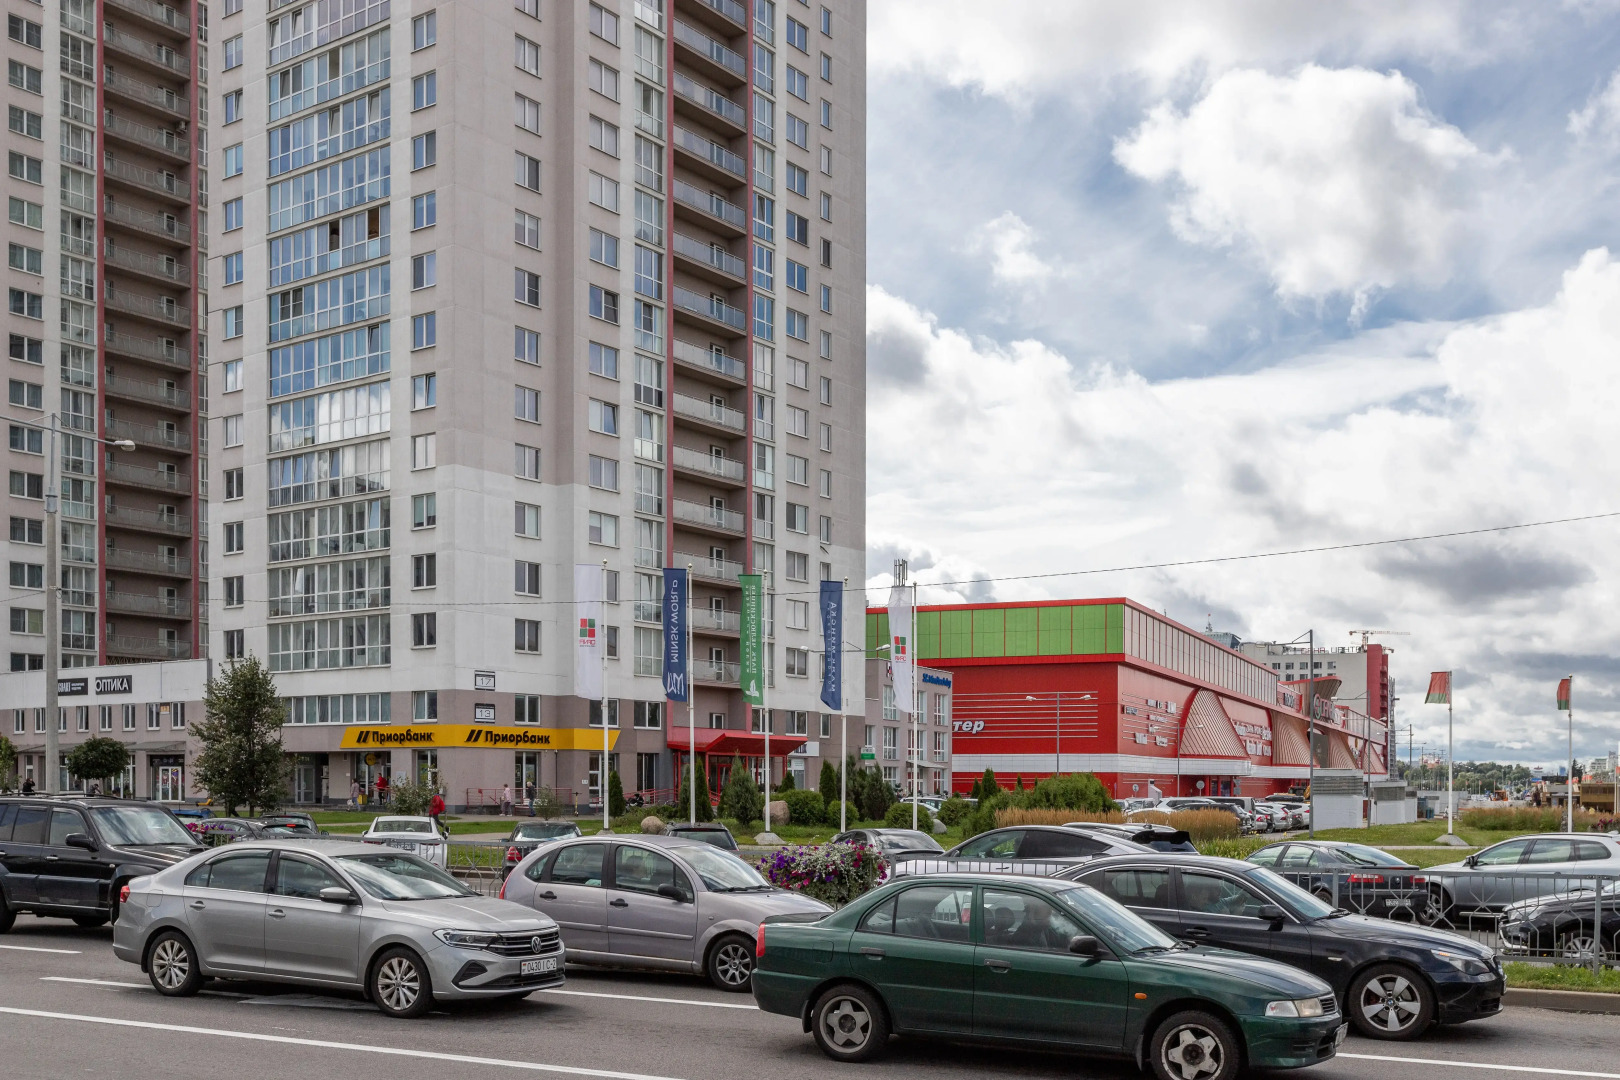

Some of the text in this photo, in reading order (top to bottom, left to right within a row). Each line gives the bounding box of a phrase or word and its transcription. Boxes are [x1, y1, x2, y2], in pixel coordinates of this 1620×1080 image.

[96, 678, 128, 692] ОПТИКА
[372, 730, 434, 744] Приорбанк
[485, 731, 550, 745] Приорбанк
